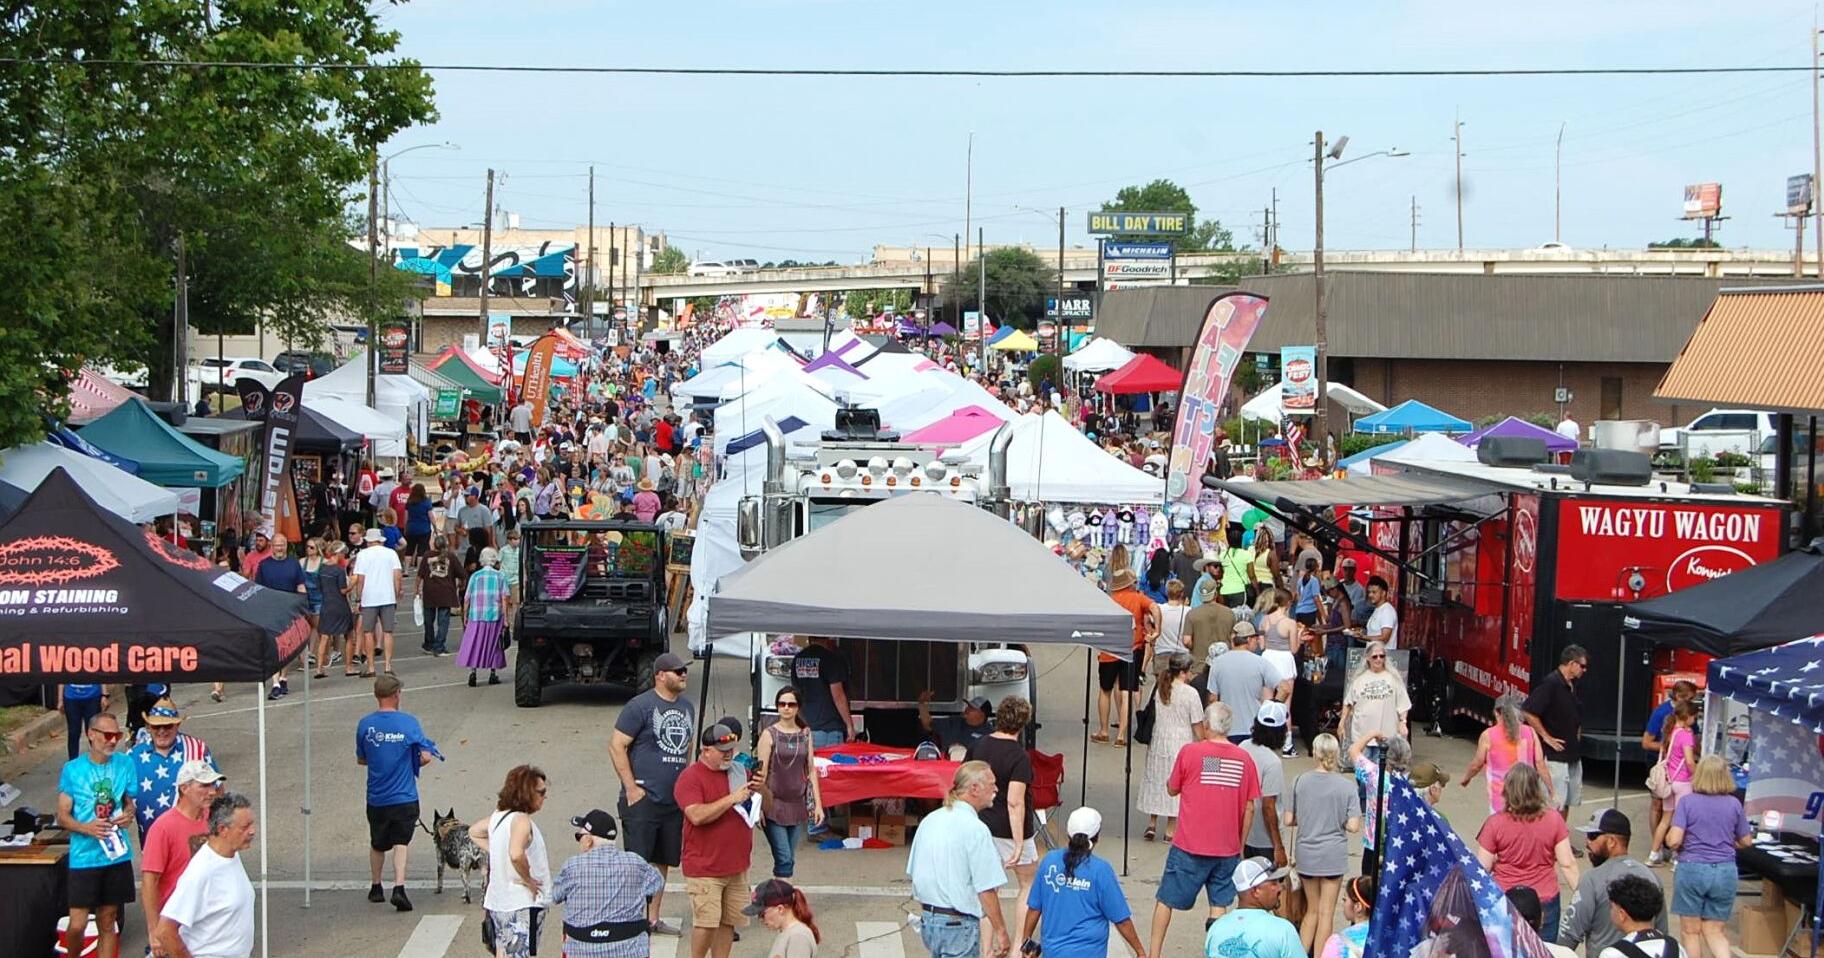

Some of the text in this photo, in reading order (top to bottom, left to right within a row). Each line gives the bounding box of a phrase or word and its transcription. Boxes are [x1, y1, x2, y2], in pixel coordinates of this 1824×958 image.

[1092, 215, 1184, 231] BILL DAY TIRE
[1121, 247, 1168, 255] MICHELIN
[1579, 506, 1761, 542] WAGYU WAGON
[47, 555, 81, 566] 14:6
[34, 589, 119, 604] STAINING
[43, 606, 129, 614] Refurbishing
[0, 643, 31, 673] al
[590, 928, 610, 938] drive
